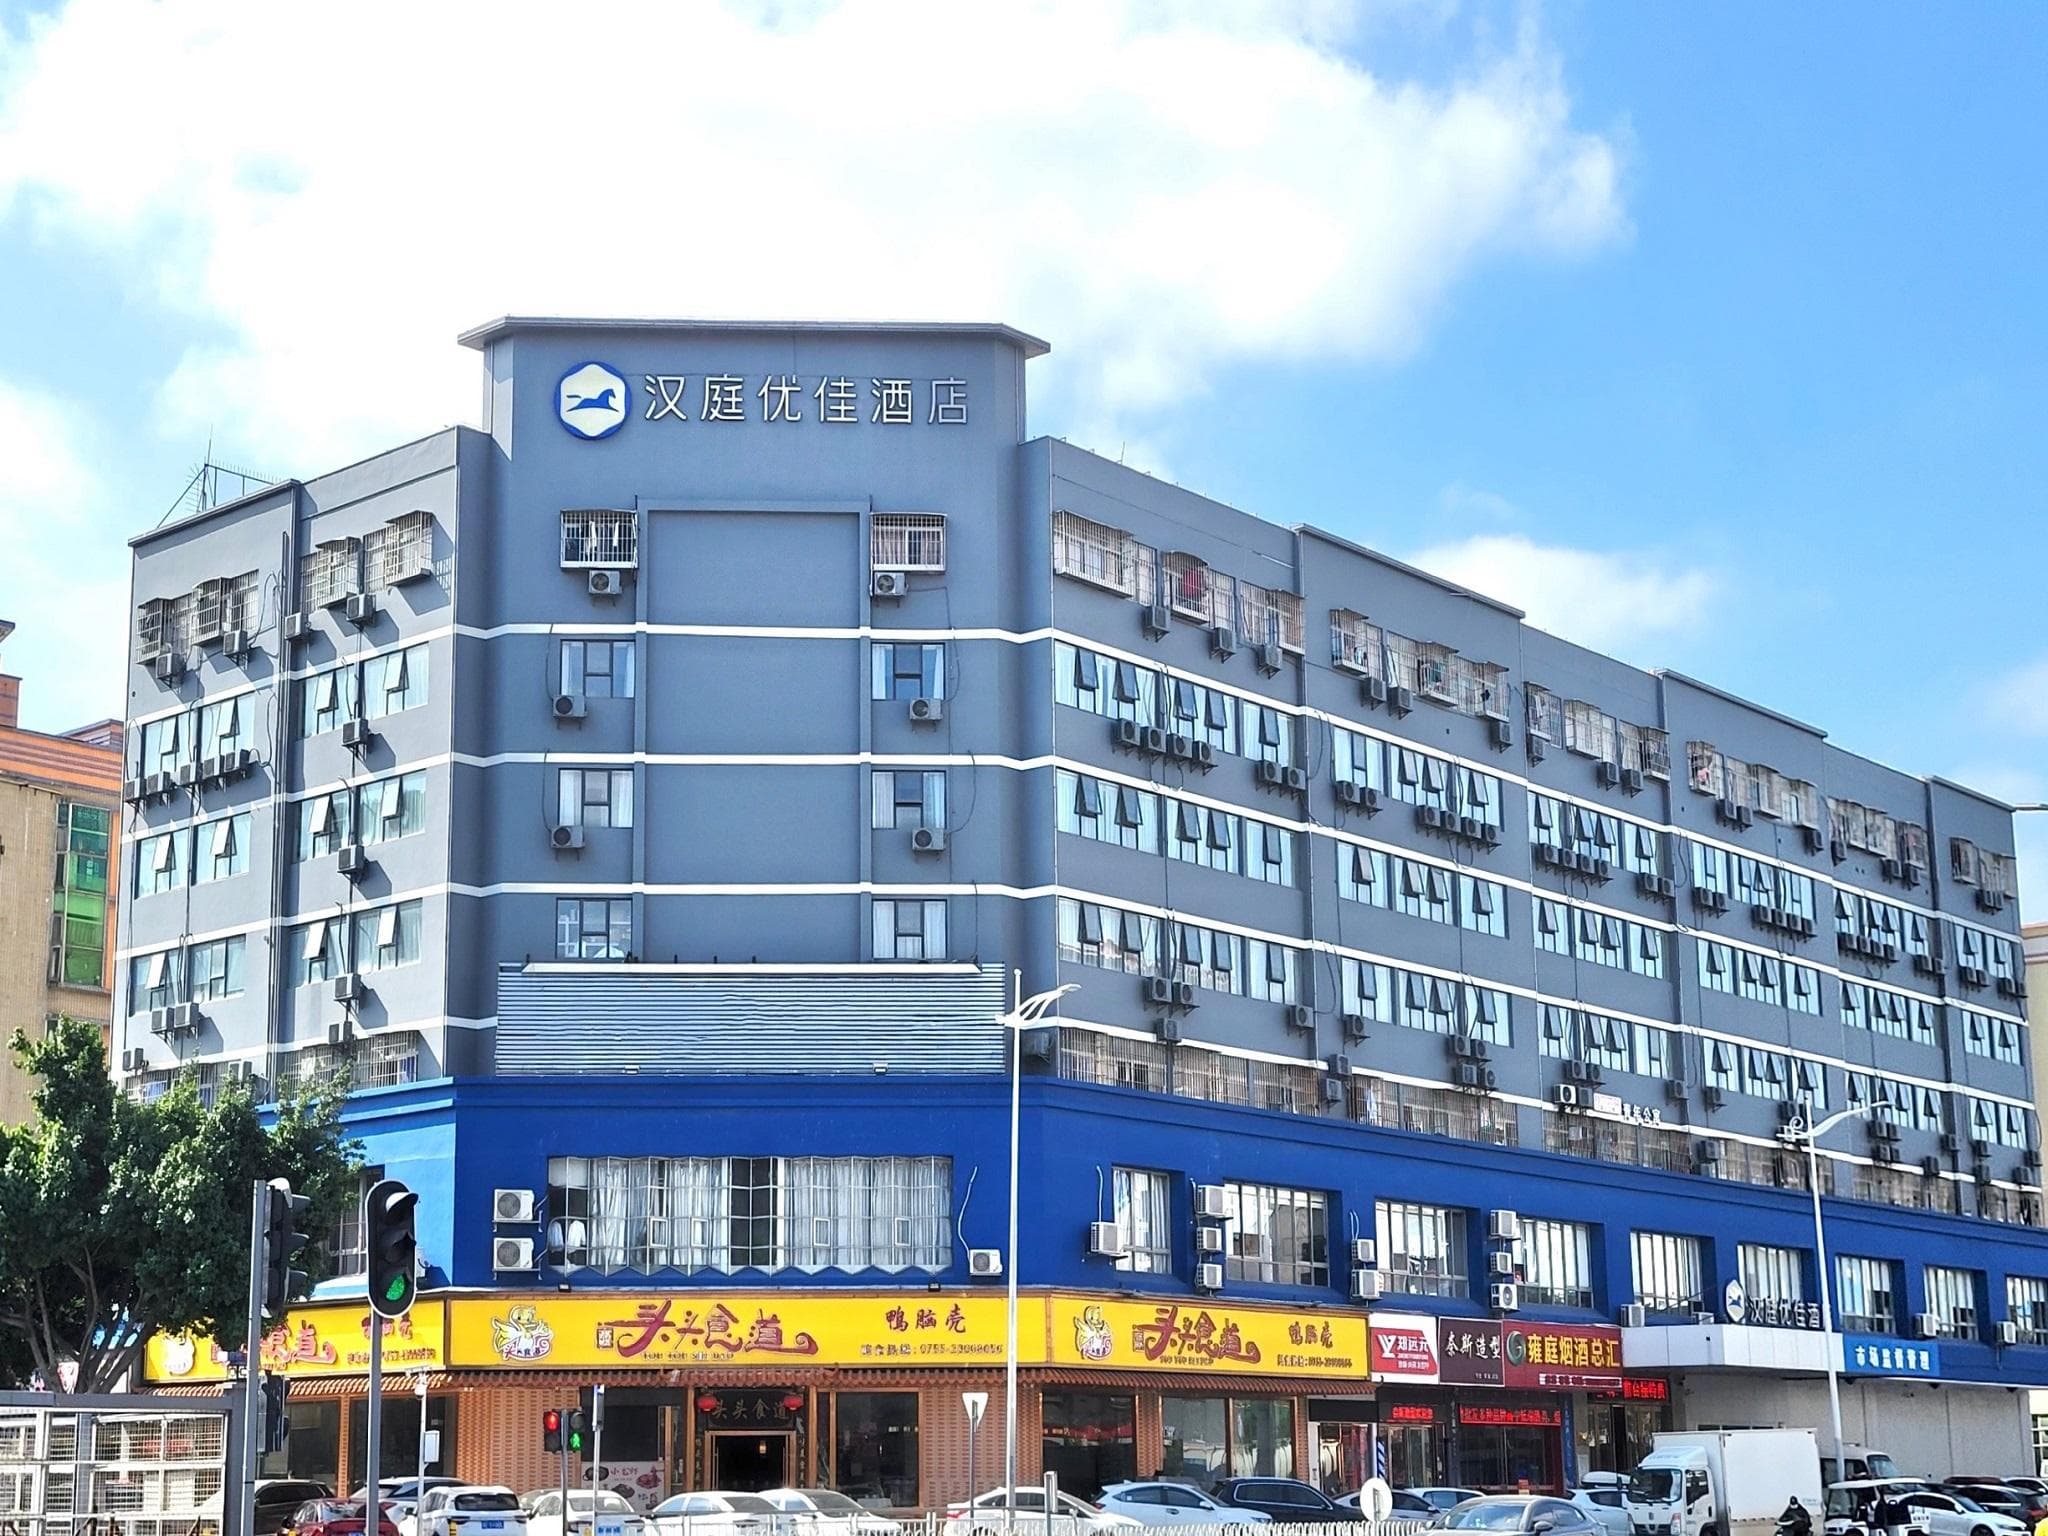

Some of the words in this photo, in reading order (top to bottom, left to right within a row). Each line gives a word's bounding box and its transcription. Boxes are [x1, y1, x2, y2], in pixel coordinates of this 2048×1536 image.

[643, 374, 969, 425] 汉庭优佳酒店
[885, 1304, 967, 1333] 鸭脑壳
[1749, 1297, 1831, 1328] 汉庭优佳酒
[598, 1299, 819, 1357] 头头食道
[1132, 1306, 1261, 1364] 头头食道
[1397, 1335, 1430, 1353] 郑远元
[1446, 1331, 1502, 1359] 奈斯造型
[1528, 1334, 1621, 1368] 雍庭烟酒总汇
[1855, 1346, 1931, 1372] 市场监督管理
[712, 1399, 788, 1421] 头头食道
